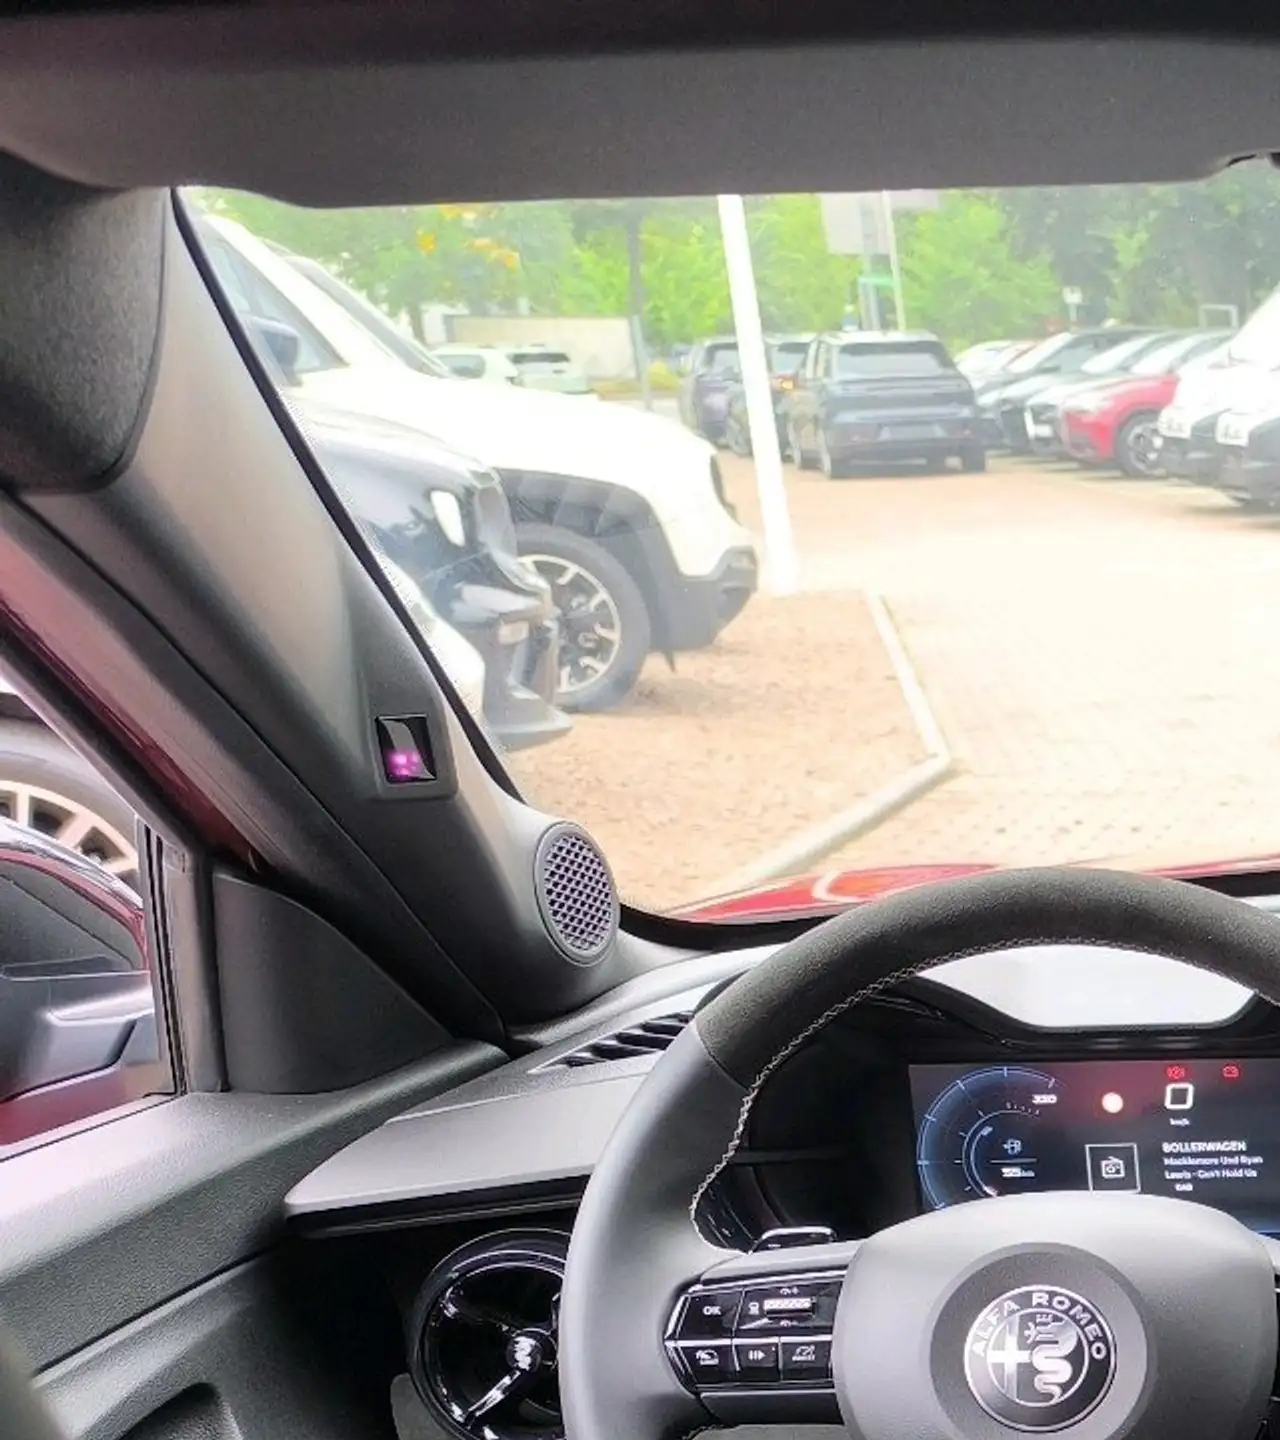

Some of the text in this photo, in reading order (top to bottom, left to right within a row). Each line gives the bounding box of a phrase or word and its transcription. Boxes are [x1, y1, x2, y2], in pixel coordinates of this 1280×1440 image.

[1162, 1141, 1247, 1153] BOLLERWAGEN
[1222, 1168, 1242, 1177] Hold
[703, 1305, 722, 1316] OK
[971, 1292, 1107, 1360] ALFA ROMEO
